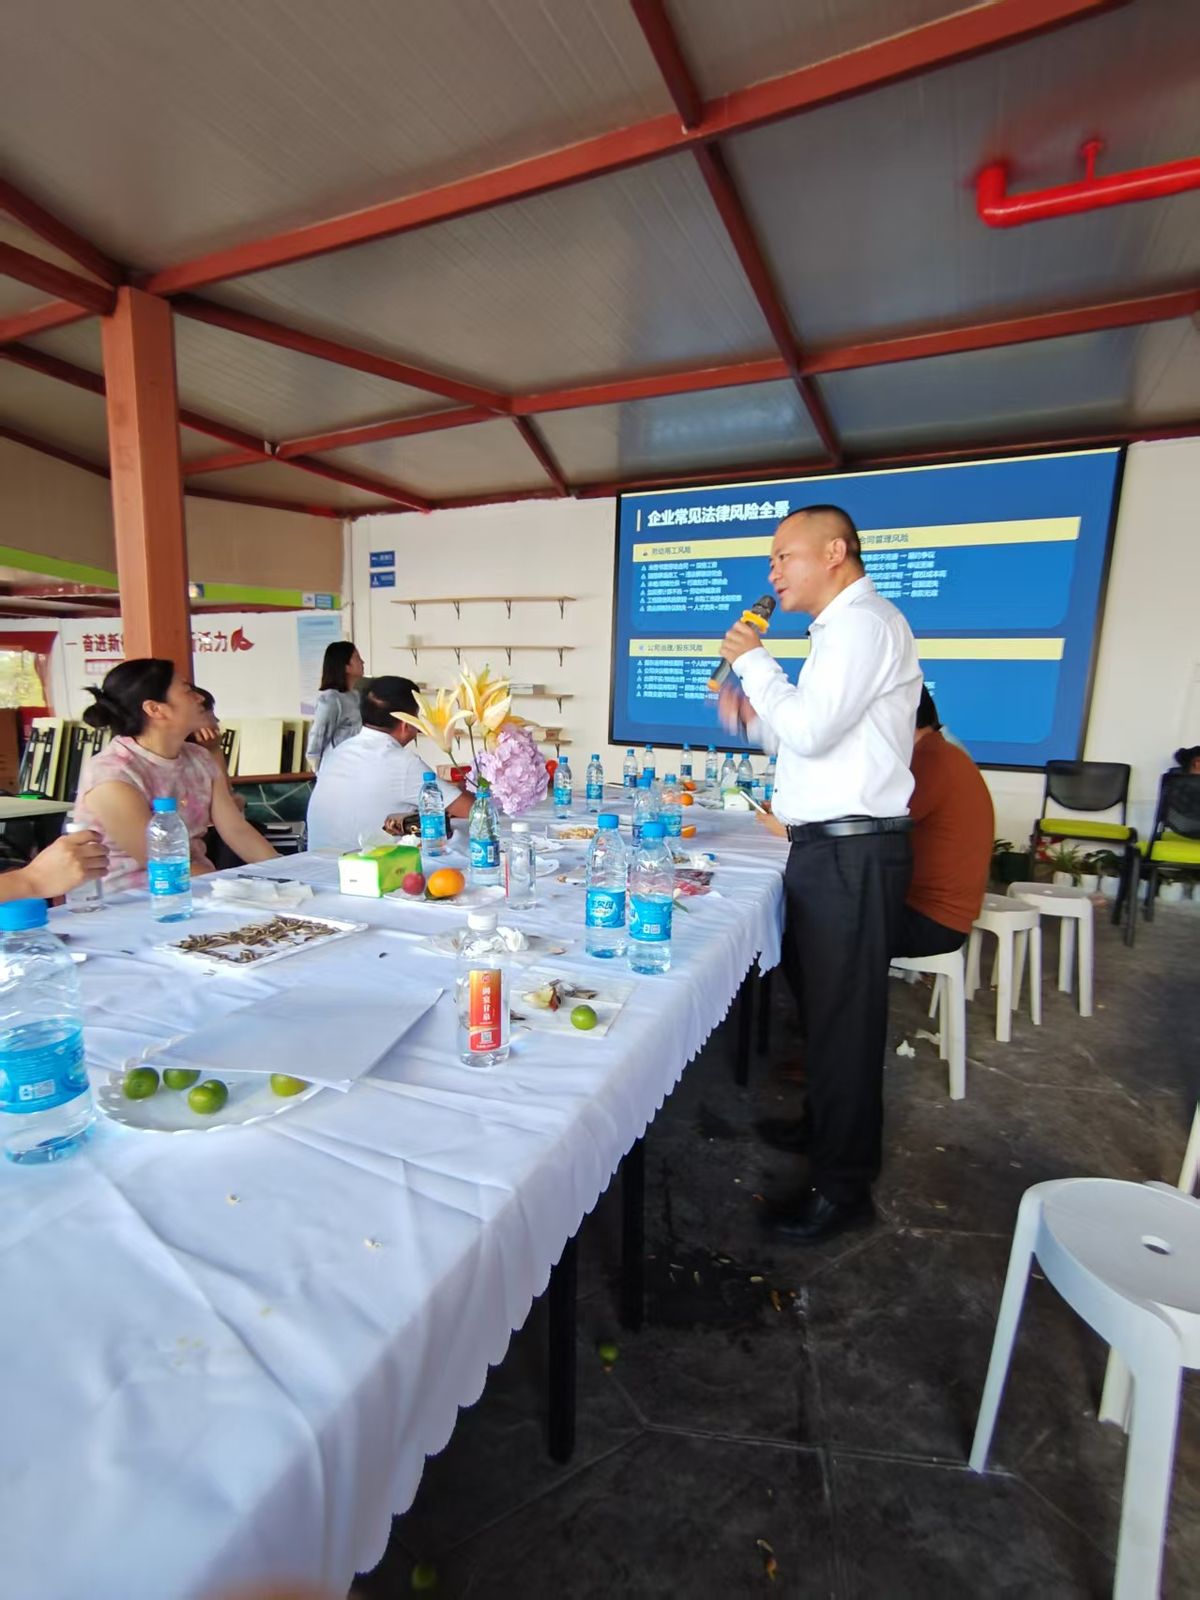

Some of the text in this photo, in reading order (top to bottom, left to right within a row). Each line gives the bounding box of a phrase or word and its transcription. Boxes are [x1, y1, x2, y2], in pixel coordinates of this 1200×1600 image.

[647, 500, 790, 527] 企业常见法律风险全景
[82, 633, 124, 652] 奋进新
